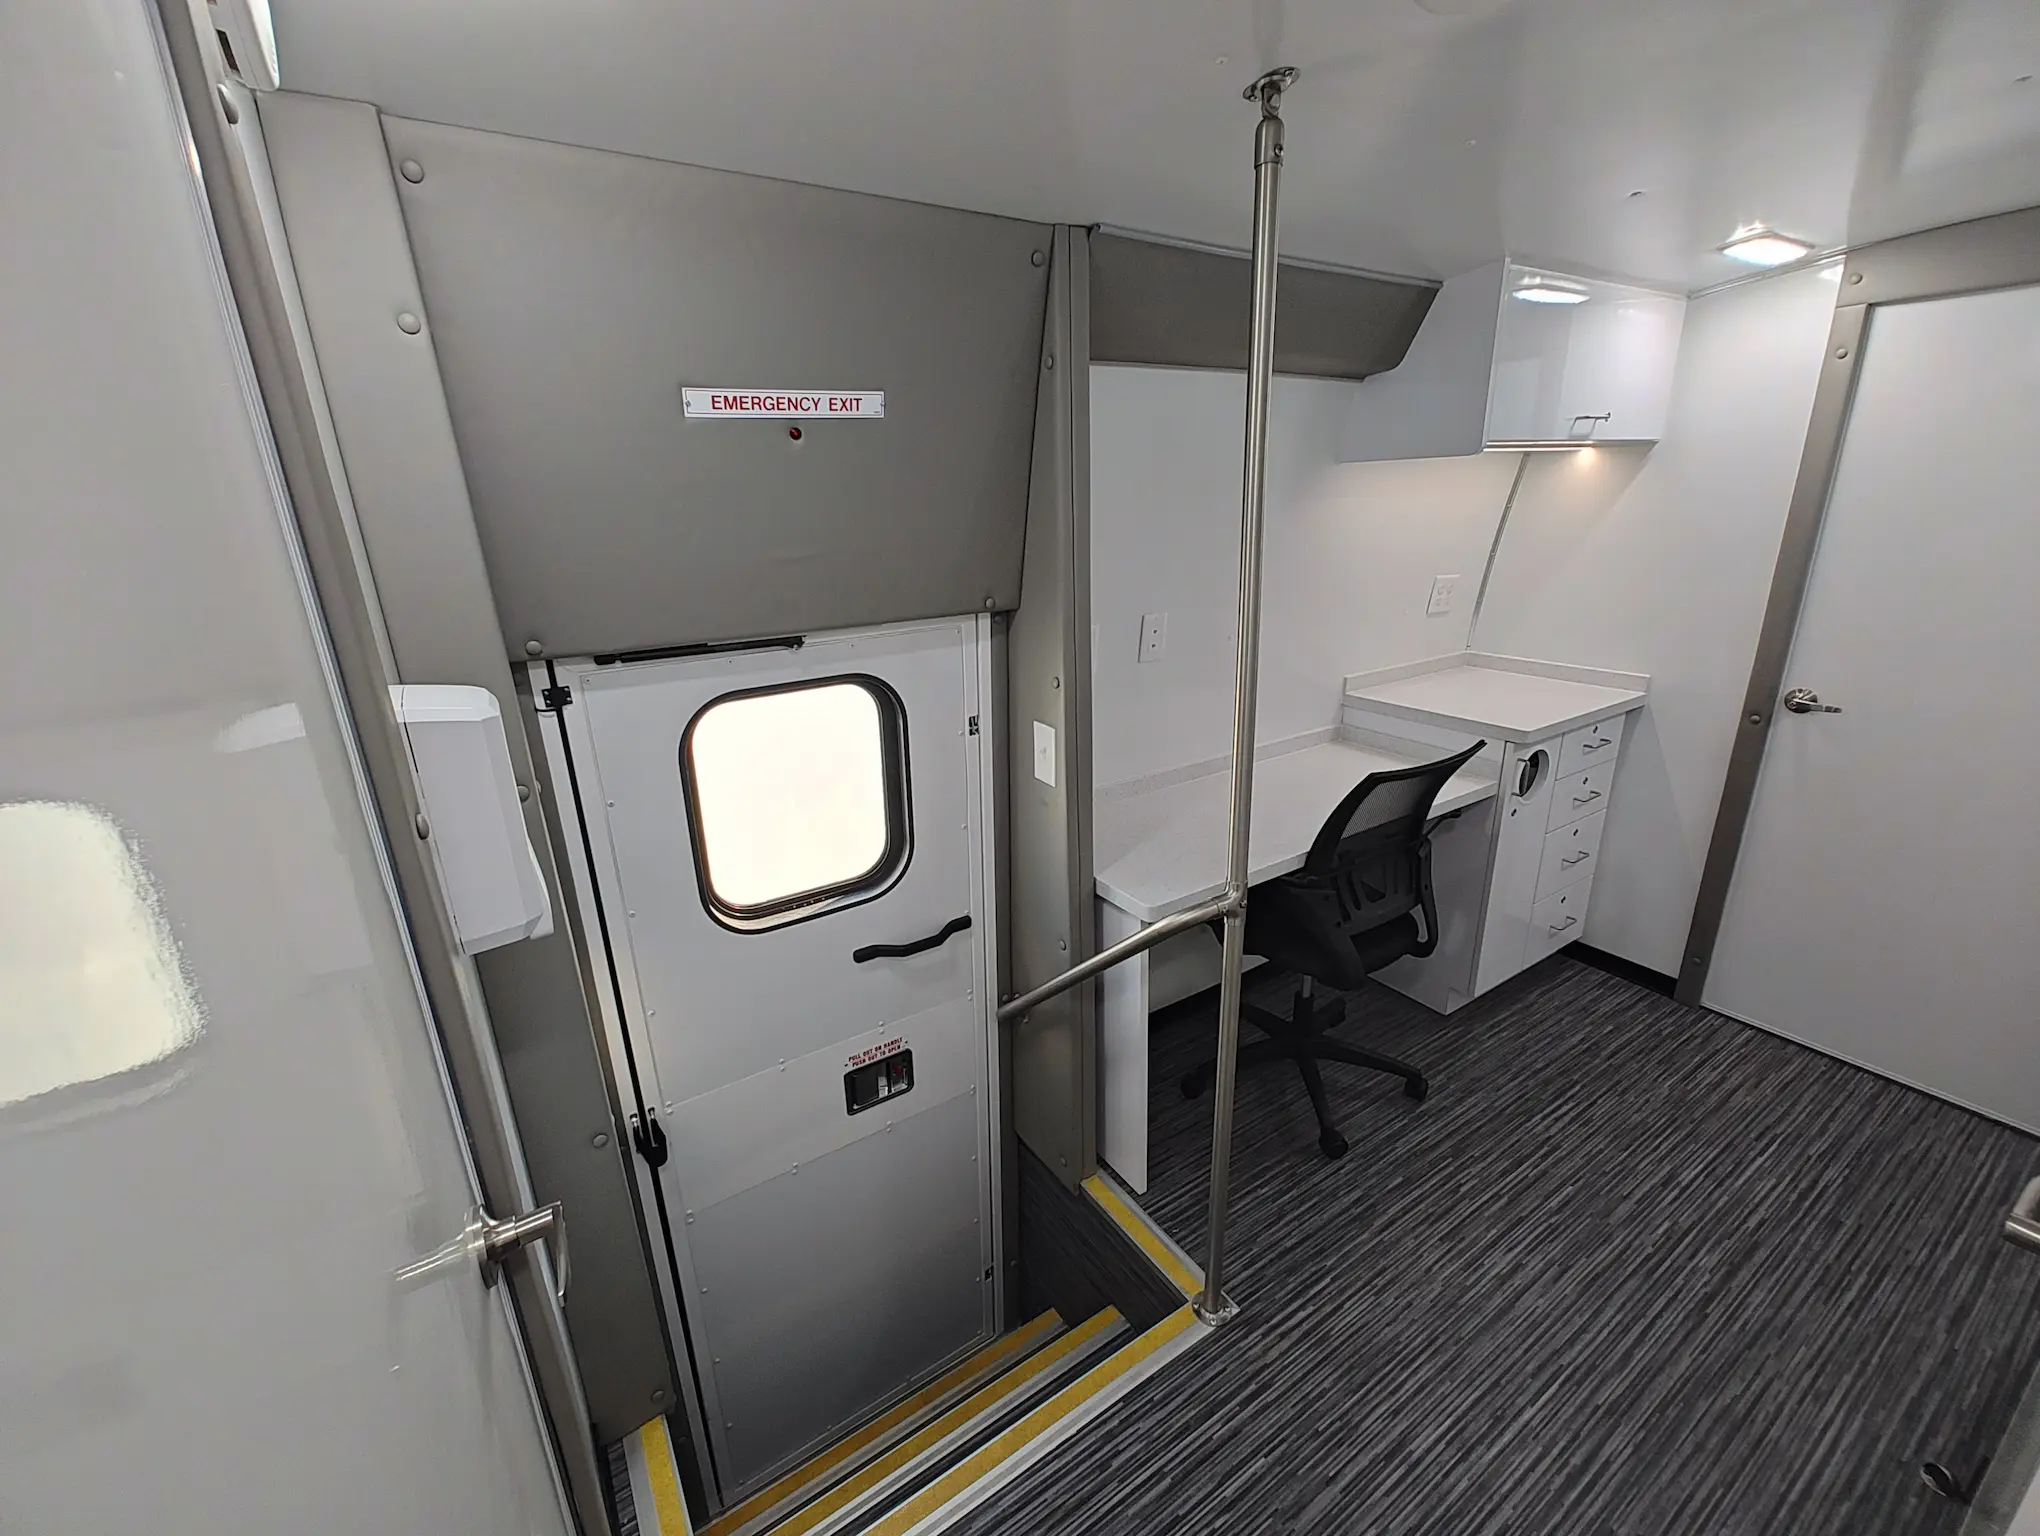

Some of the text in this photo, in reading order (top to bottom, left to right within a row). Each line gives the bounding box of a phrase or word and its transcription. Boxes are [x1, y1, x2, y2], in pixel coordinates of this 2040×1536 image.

[711, 395, 862, 412] EMERGENCY EXIT
[848, 1053, 861, 1062] PULL
[863, 1048, 873, 1057] OUT
[884, 1037, 903, 1048] HANDLE
[852, 1058, 866, 1067] PUSH
[868, 1053, 878, 1061] OUT
[888, 1044, 901, 1053] OPEN
